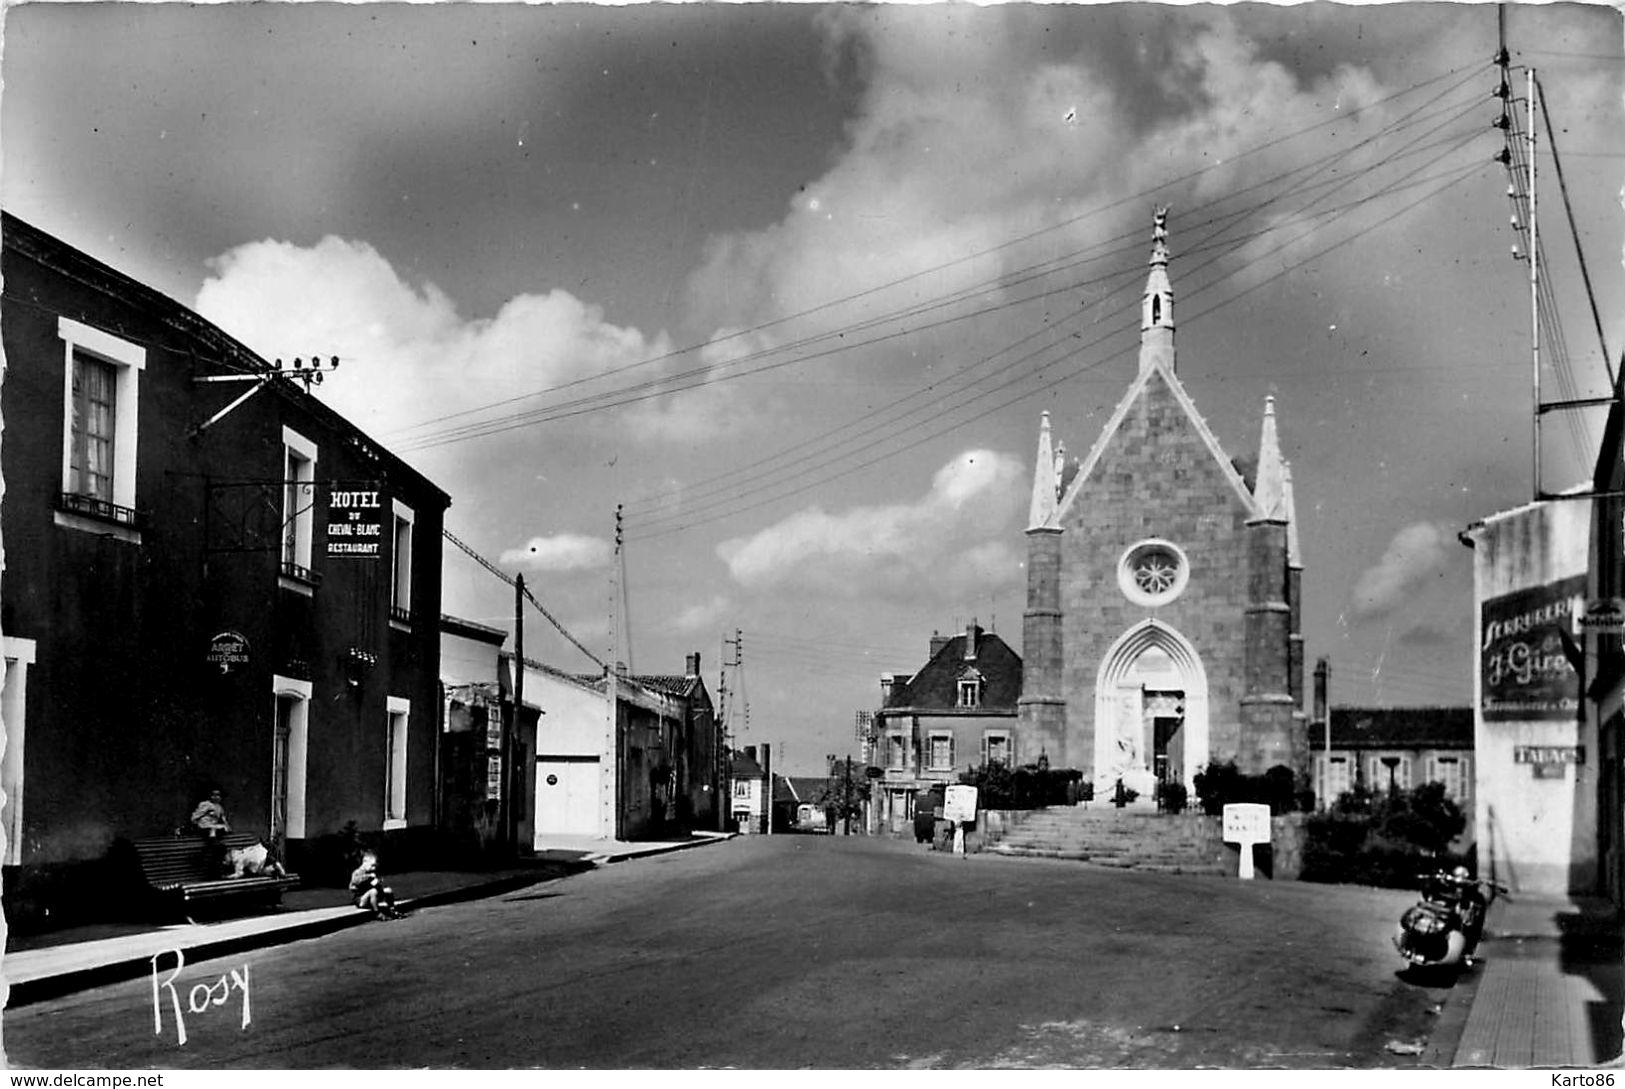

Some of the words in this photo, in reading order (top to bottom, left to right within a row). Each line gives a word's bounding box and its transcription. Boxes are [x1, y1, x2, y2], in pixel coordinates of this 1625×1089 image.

[329, 491, 381, 508] HOTEL
[348, 512, 361, 520] DU
[327, 523, 381, 536] CHEVAL-BLANC
[327, 543, 379, 553] RESTAURANT
[1483, 597, 1574, 651] SERRURERI
[206, 654, 250, 663] AUTOBUS
